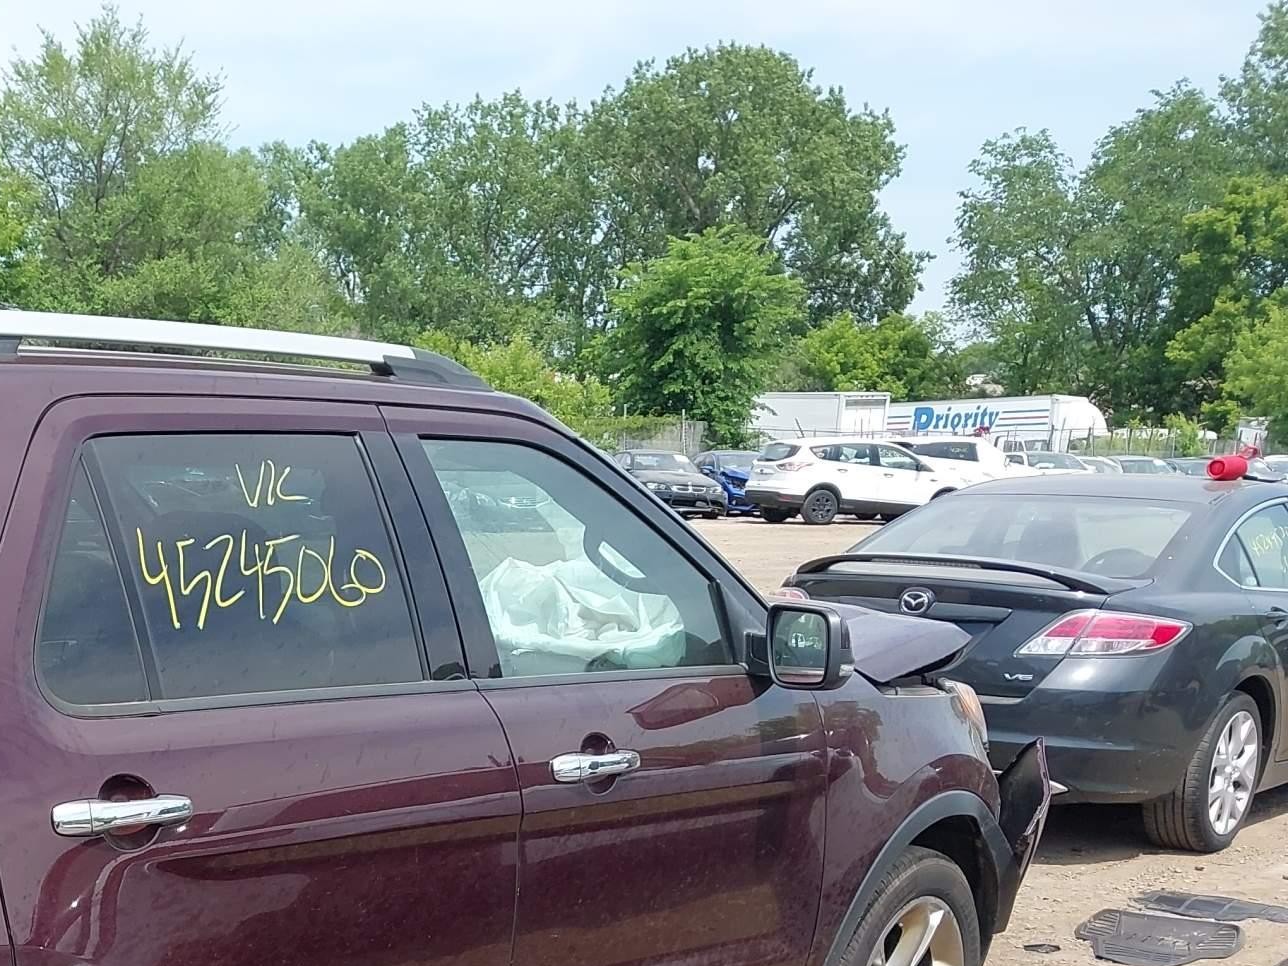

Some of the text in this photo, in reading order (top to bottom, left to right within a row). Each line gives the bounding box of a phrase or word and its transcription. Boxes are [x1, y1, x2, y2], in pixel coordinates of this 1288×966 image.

[913, 405, 999, 431] Priority
[136, 527, 386, 630] 45245060
[1004, 673, 1033, 681] V6
